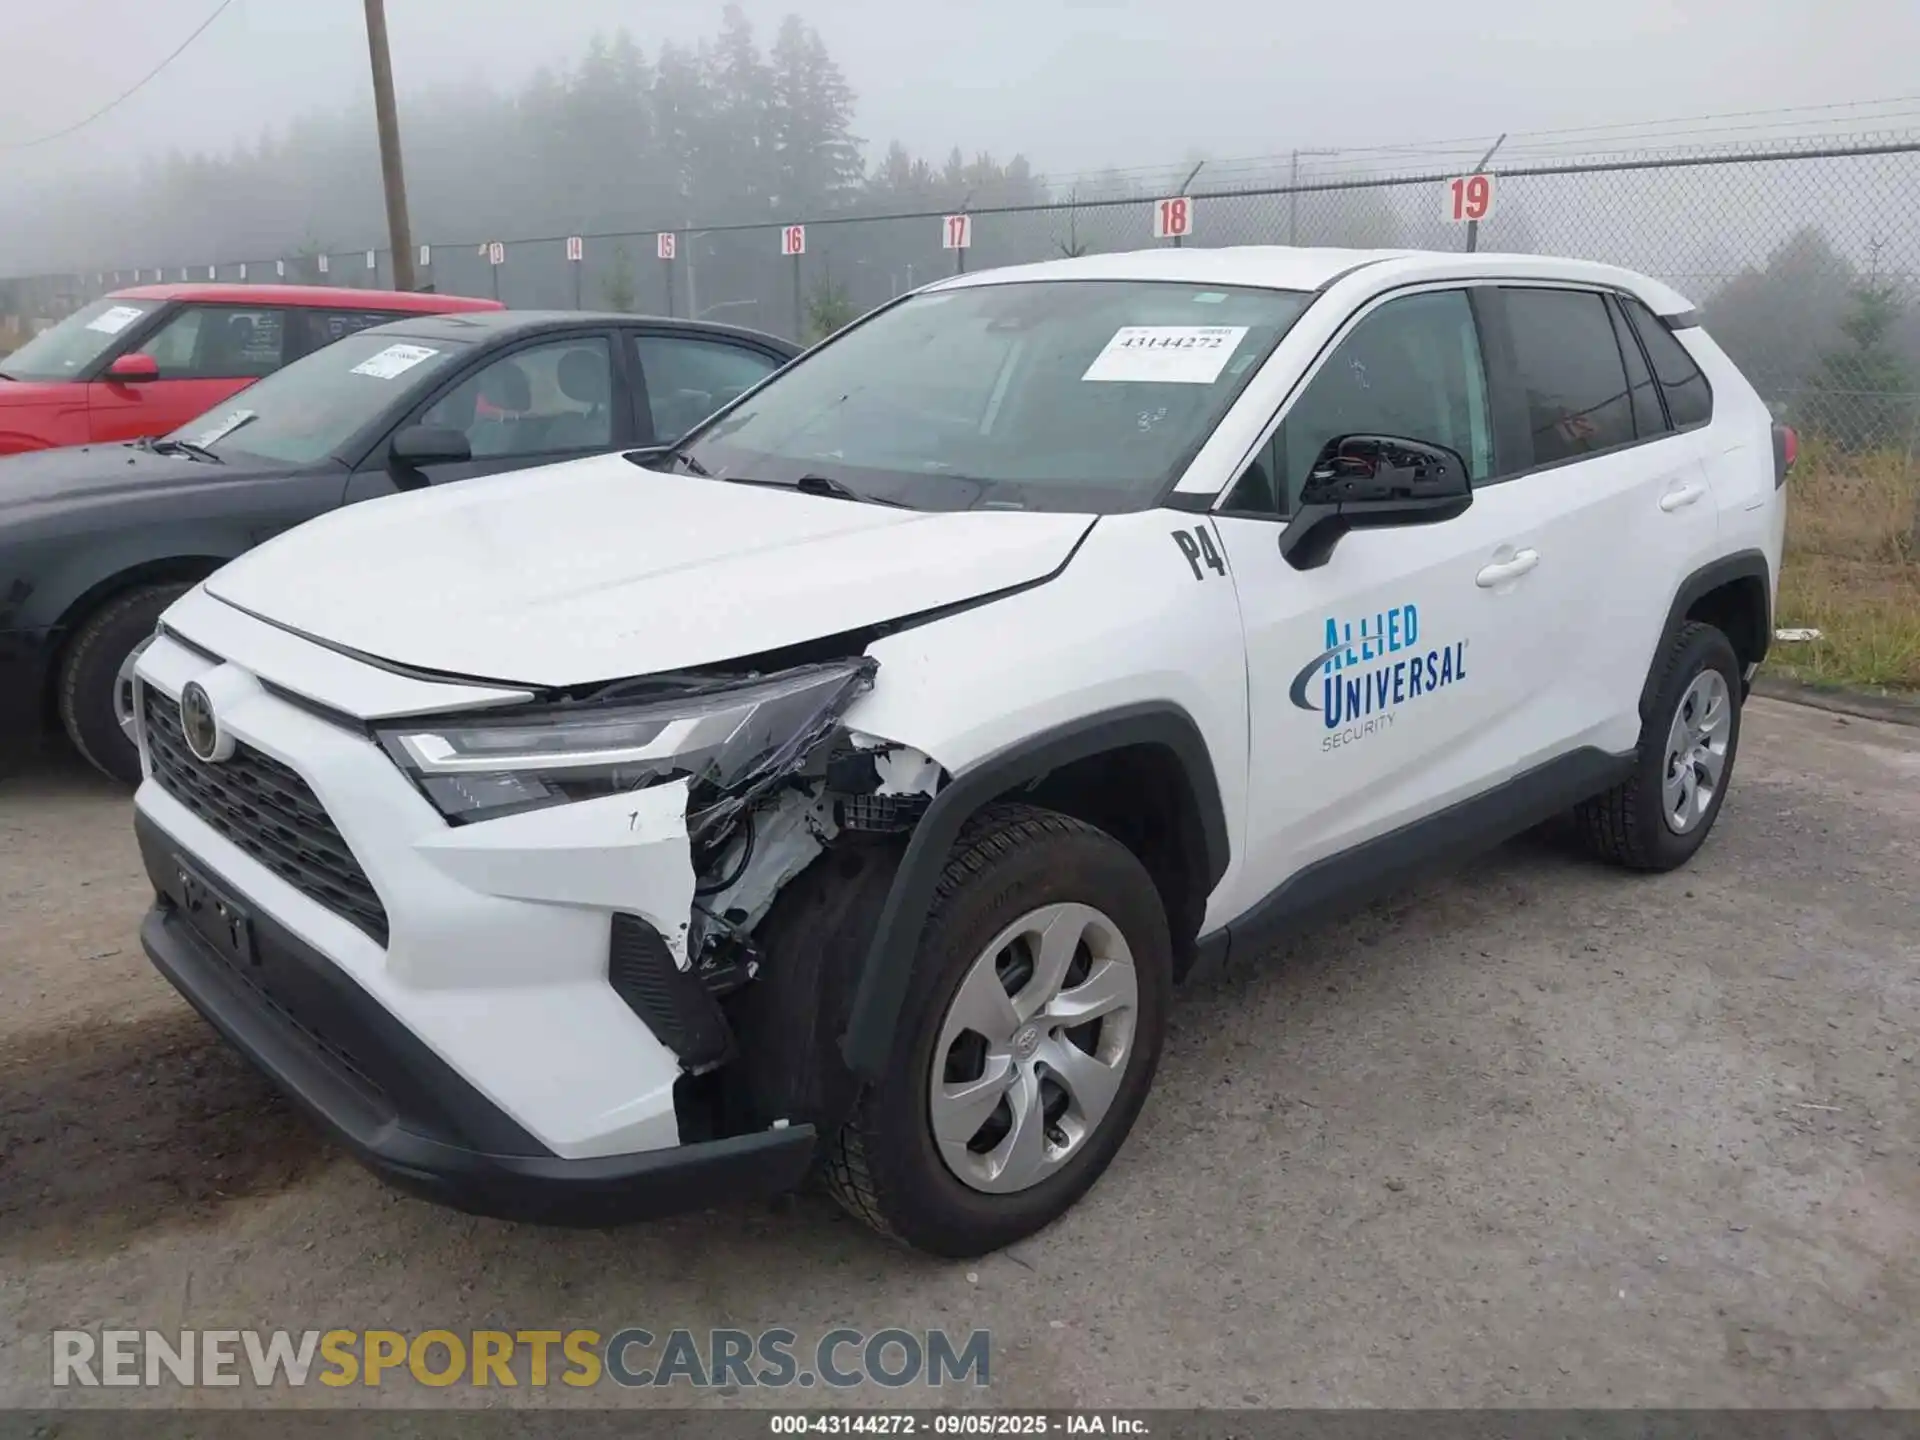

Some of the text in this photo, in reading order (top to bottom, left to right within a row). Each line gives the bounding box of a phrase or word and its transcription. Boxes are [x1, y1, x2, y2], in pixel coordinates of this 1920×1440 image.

[1160, 199, 1187, 234] 18
[1451, 176, 1490, 221] 19
[660, 233, 673, 257] 15
[786, 227, 802, 254] 16
[949, 216, 966, 246] 17
[1120, 336, 1223, 349] 43144272
[1170, 525, 1226, 581] P4
[1324, 604, 1418, 674] ALLIED
[1324, 641, 1467, 729] UNIVERSAL
[1321, 711, 1397, 752] SECURITY
